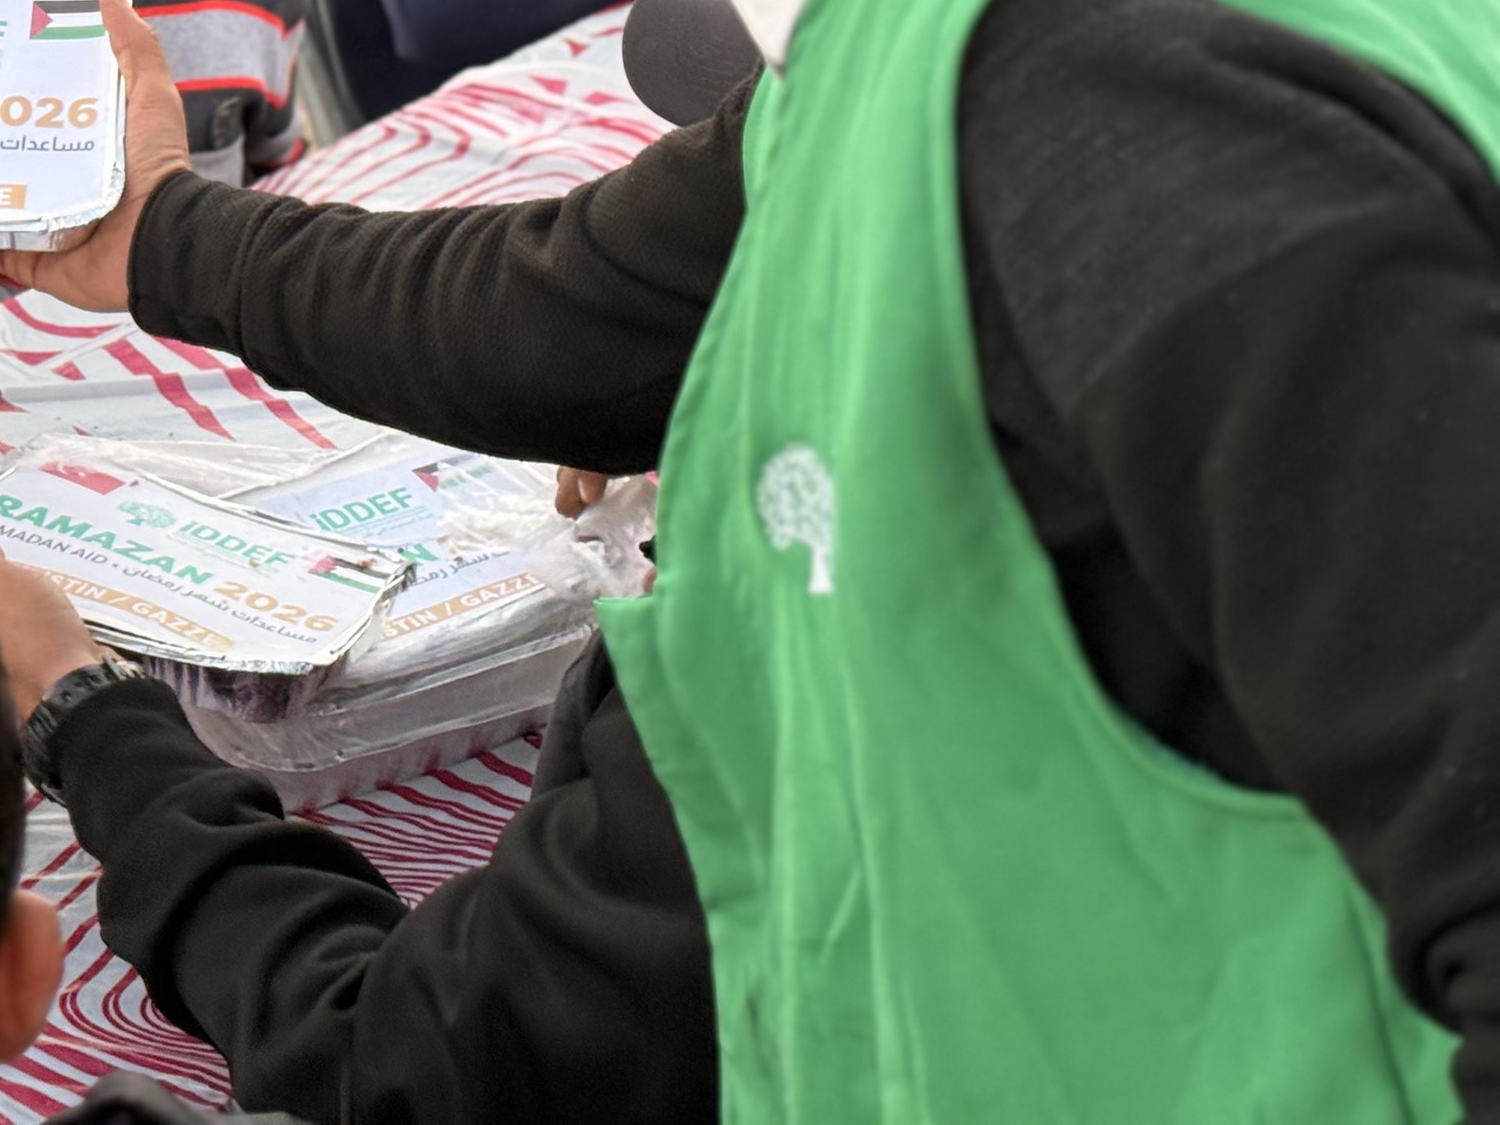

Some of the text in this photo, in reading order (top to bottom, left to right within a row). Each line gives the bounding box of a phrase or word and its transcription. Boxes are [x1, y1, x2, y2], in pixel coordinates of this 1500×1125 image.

[0, 134, 96, 152] مساعدات
[70, 547, 108, 565] AID
[122, 565, 318, 644] مساعدات شهر رمضان
[131, 601, 220, 647] GAZZE
[213, 580, 342, 632] 2026
